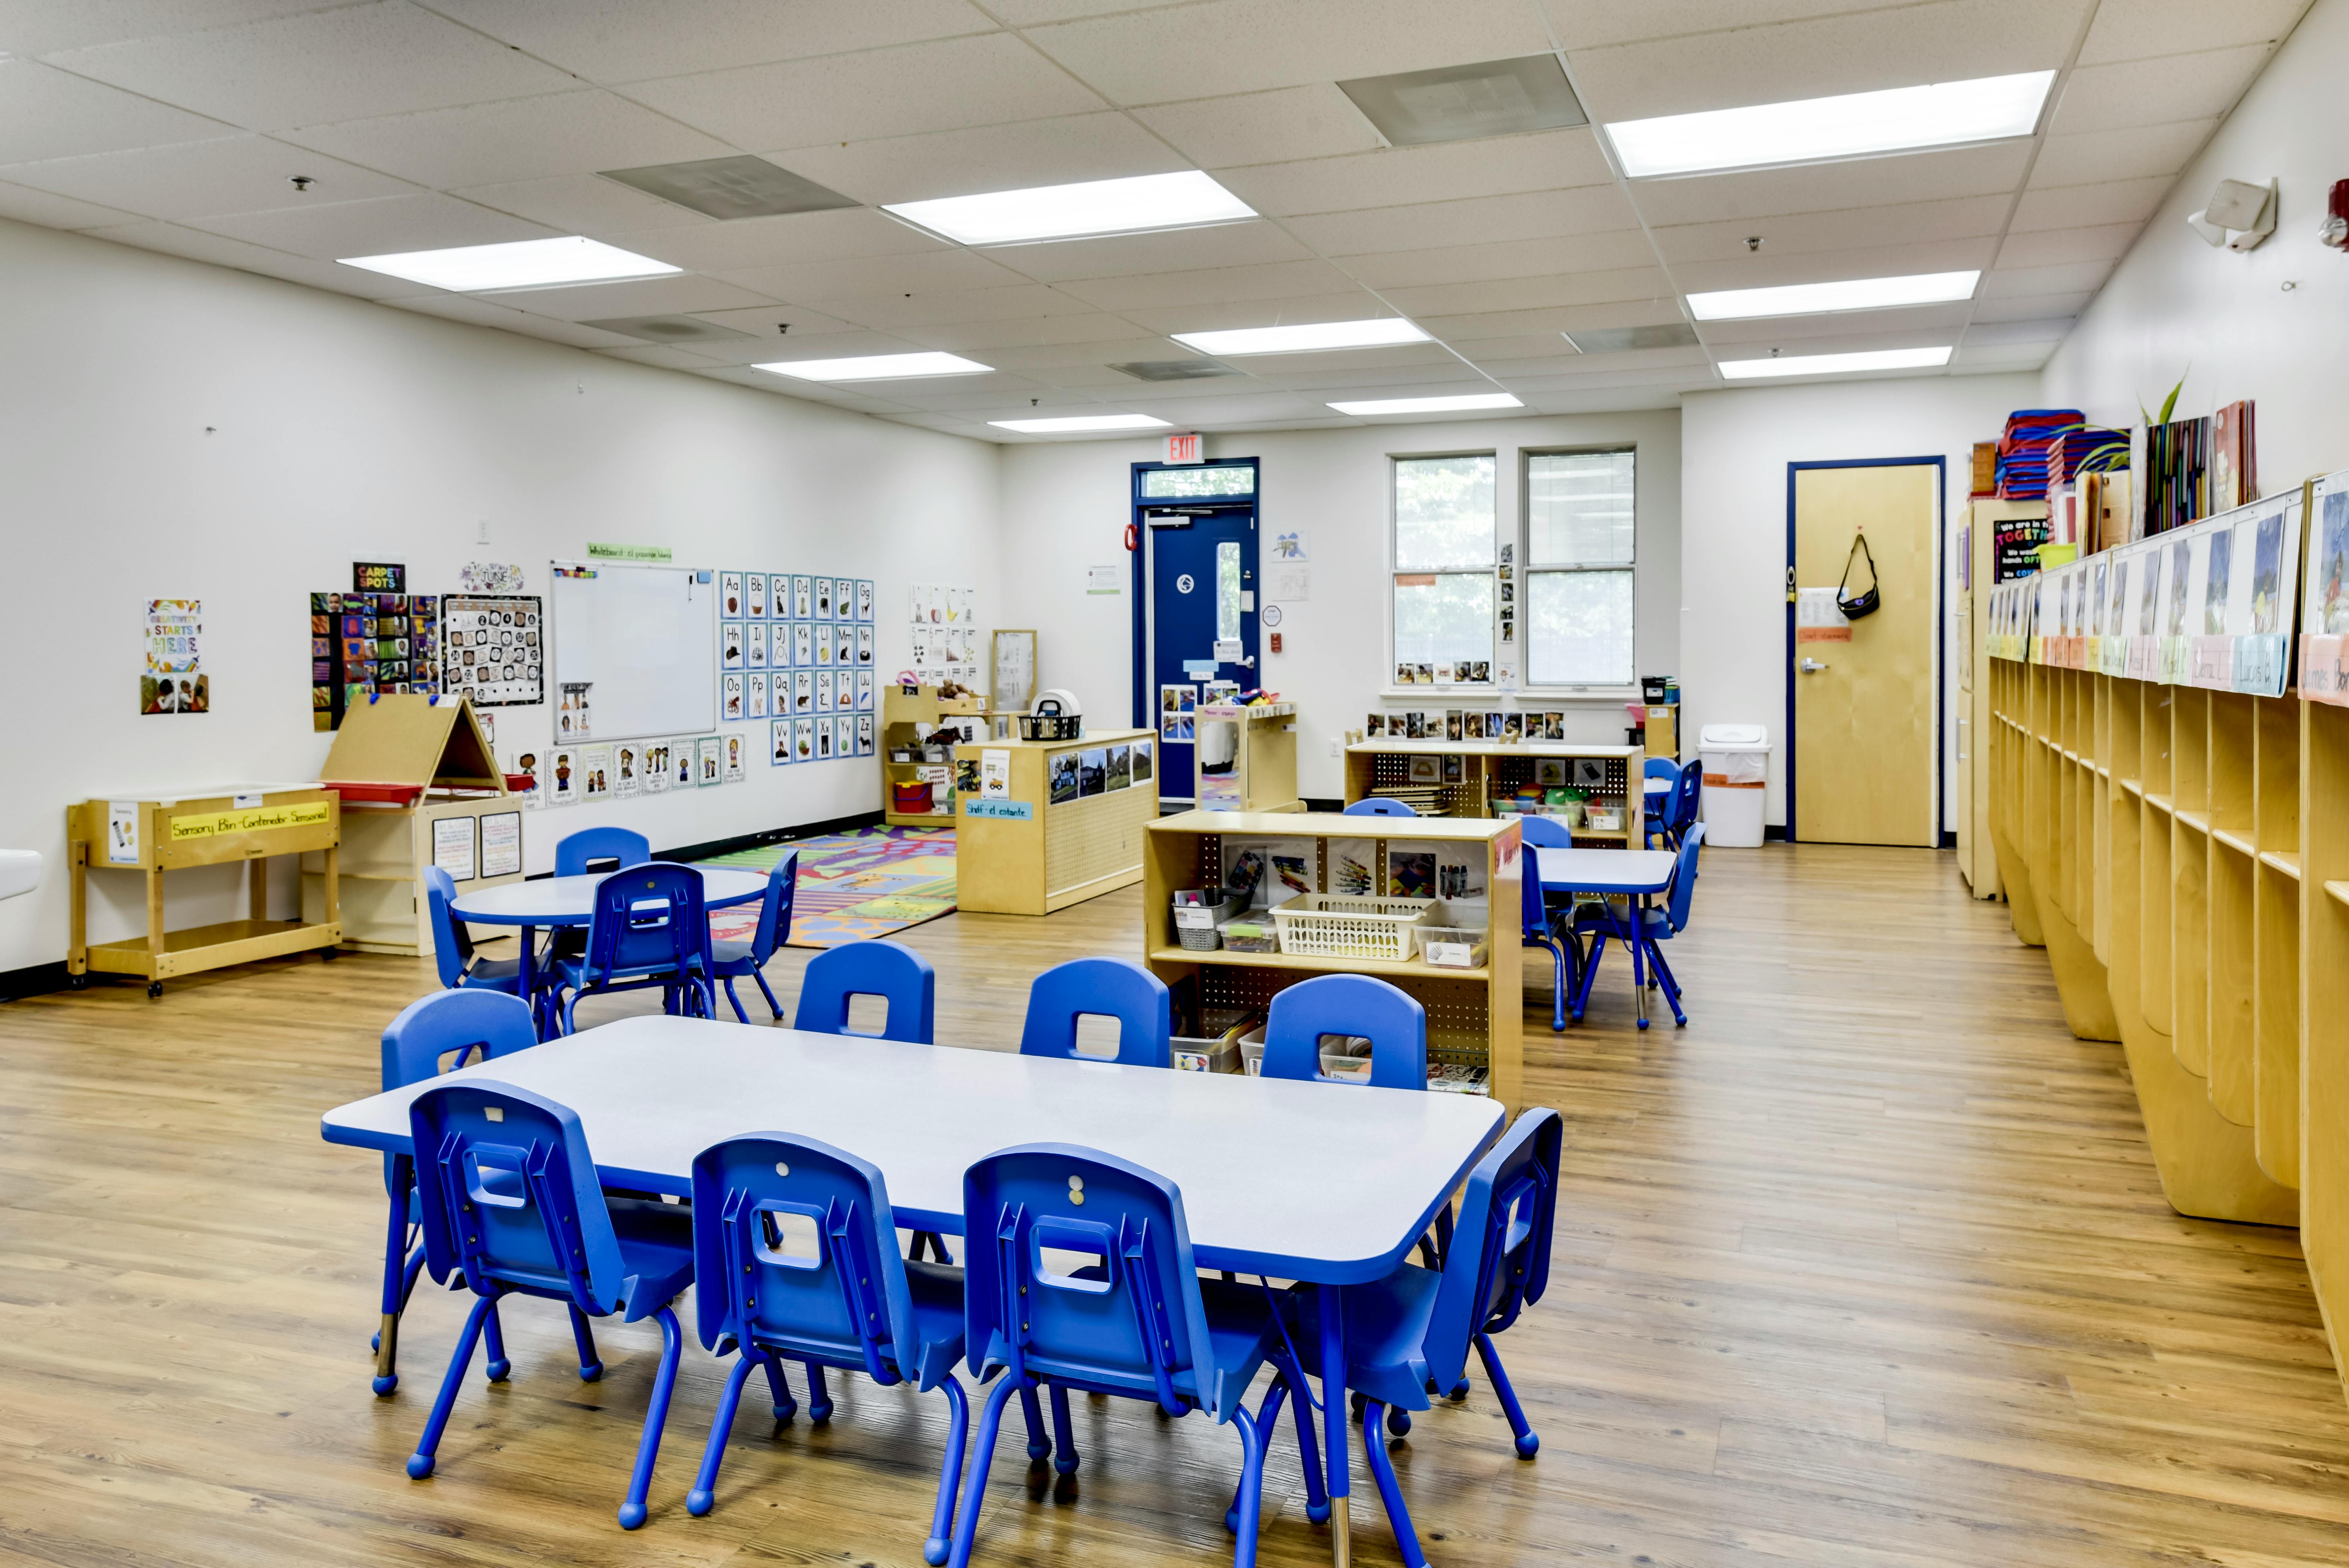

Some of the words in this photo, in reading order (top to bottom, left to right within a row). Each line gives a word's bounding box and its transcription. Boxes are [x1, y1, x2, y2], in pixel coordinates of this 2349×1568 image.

[1170, 436, 1196, 460] EXIT
[358, 566, 401, 578] CARPET
[481, 571, 508, 582] JUNE
[360, 577, 395, 588] SPOTS
[726, 577, 738, 591] Aa
[751, 577, 762, 592] Bb
[775, 579, 785, 592] Cc
[798, 580, 808, 593] Dd
[819, 581, 829, 595] Ee
[840, 583, 850, 596] Ff
[860, 584, 870, 600] Gg
[155, 625, 193, 635] STARTS
[727, 627, 739, 641] Hh
[754, 627, 761, 641] Ii
[777, 627, 785, 644] Jj
[798, 627, 808, 640] Kk
[821, 628, 828, 641] Ll
[838, 629, 852, 641] Mm
[860, 629, 870, 641] Nn
[153, 637, 197, 655] HERE
[2240, 651, 2262, 684] Lucas
[727, 678, 740, 692] Oo
[753, 677, 763, 693] Pp
[776, 676, 788, 692] Qq
[799, 674, 808, 688] Rr
[820, 674, 829, 688] Ss
[841, 673, 850, 686] Tt
[860, 674, 870, 686] Uu
[776, 725, 787, 737] Vv
[796, 723, 811, 735] Ww
[820, 721, 829, 733] Xx
[841, 720, 850, 735] Yy
[860, 718, 870, 731] Zz
[999, 807, 1026, 817] estante
[173, 823, 214, 836] Sensory
[218, 818, 236, 831] Bin
[290, 807, 327, 823] Sensorial
